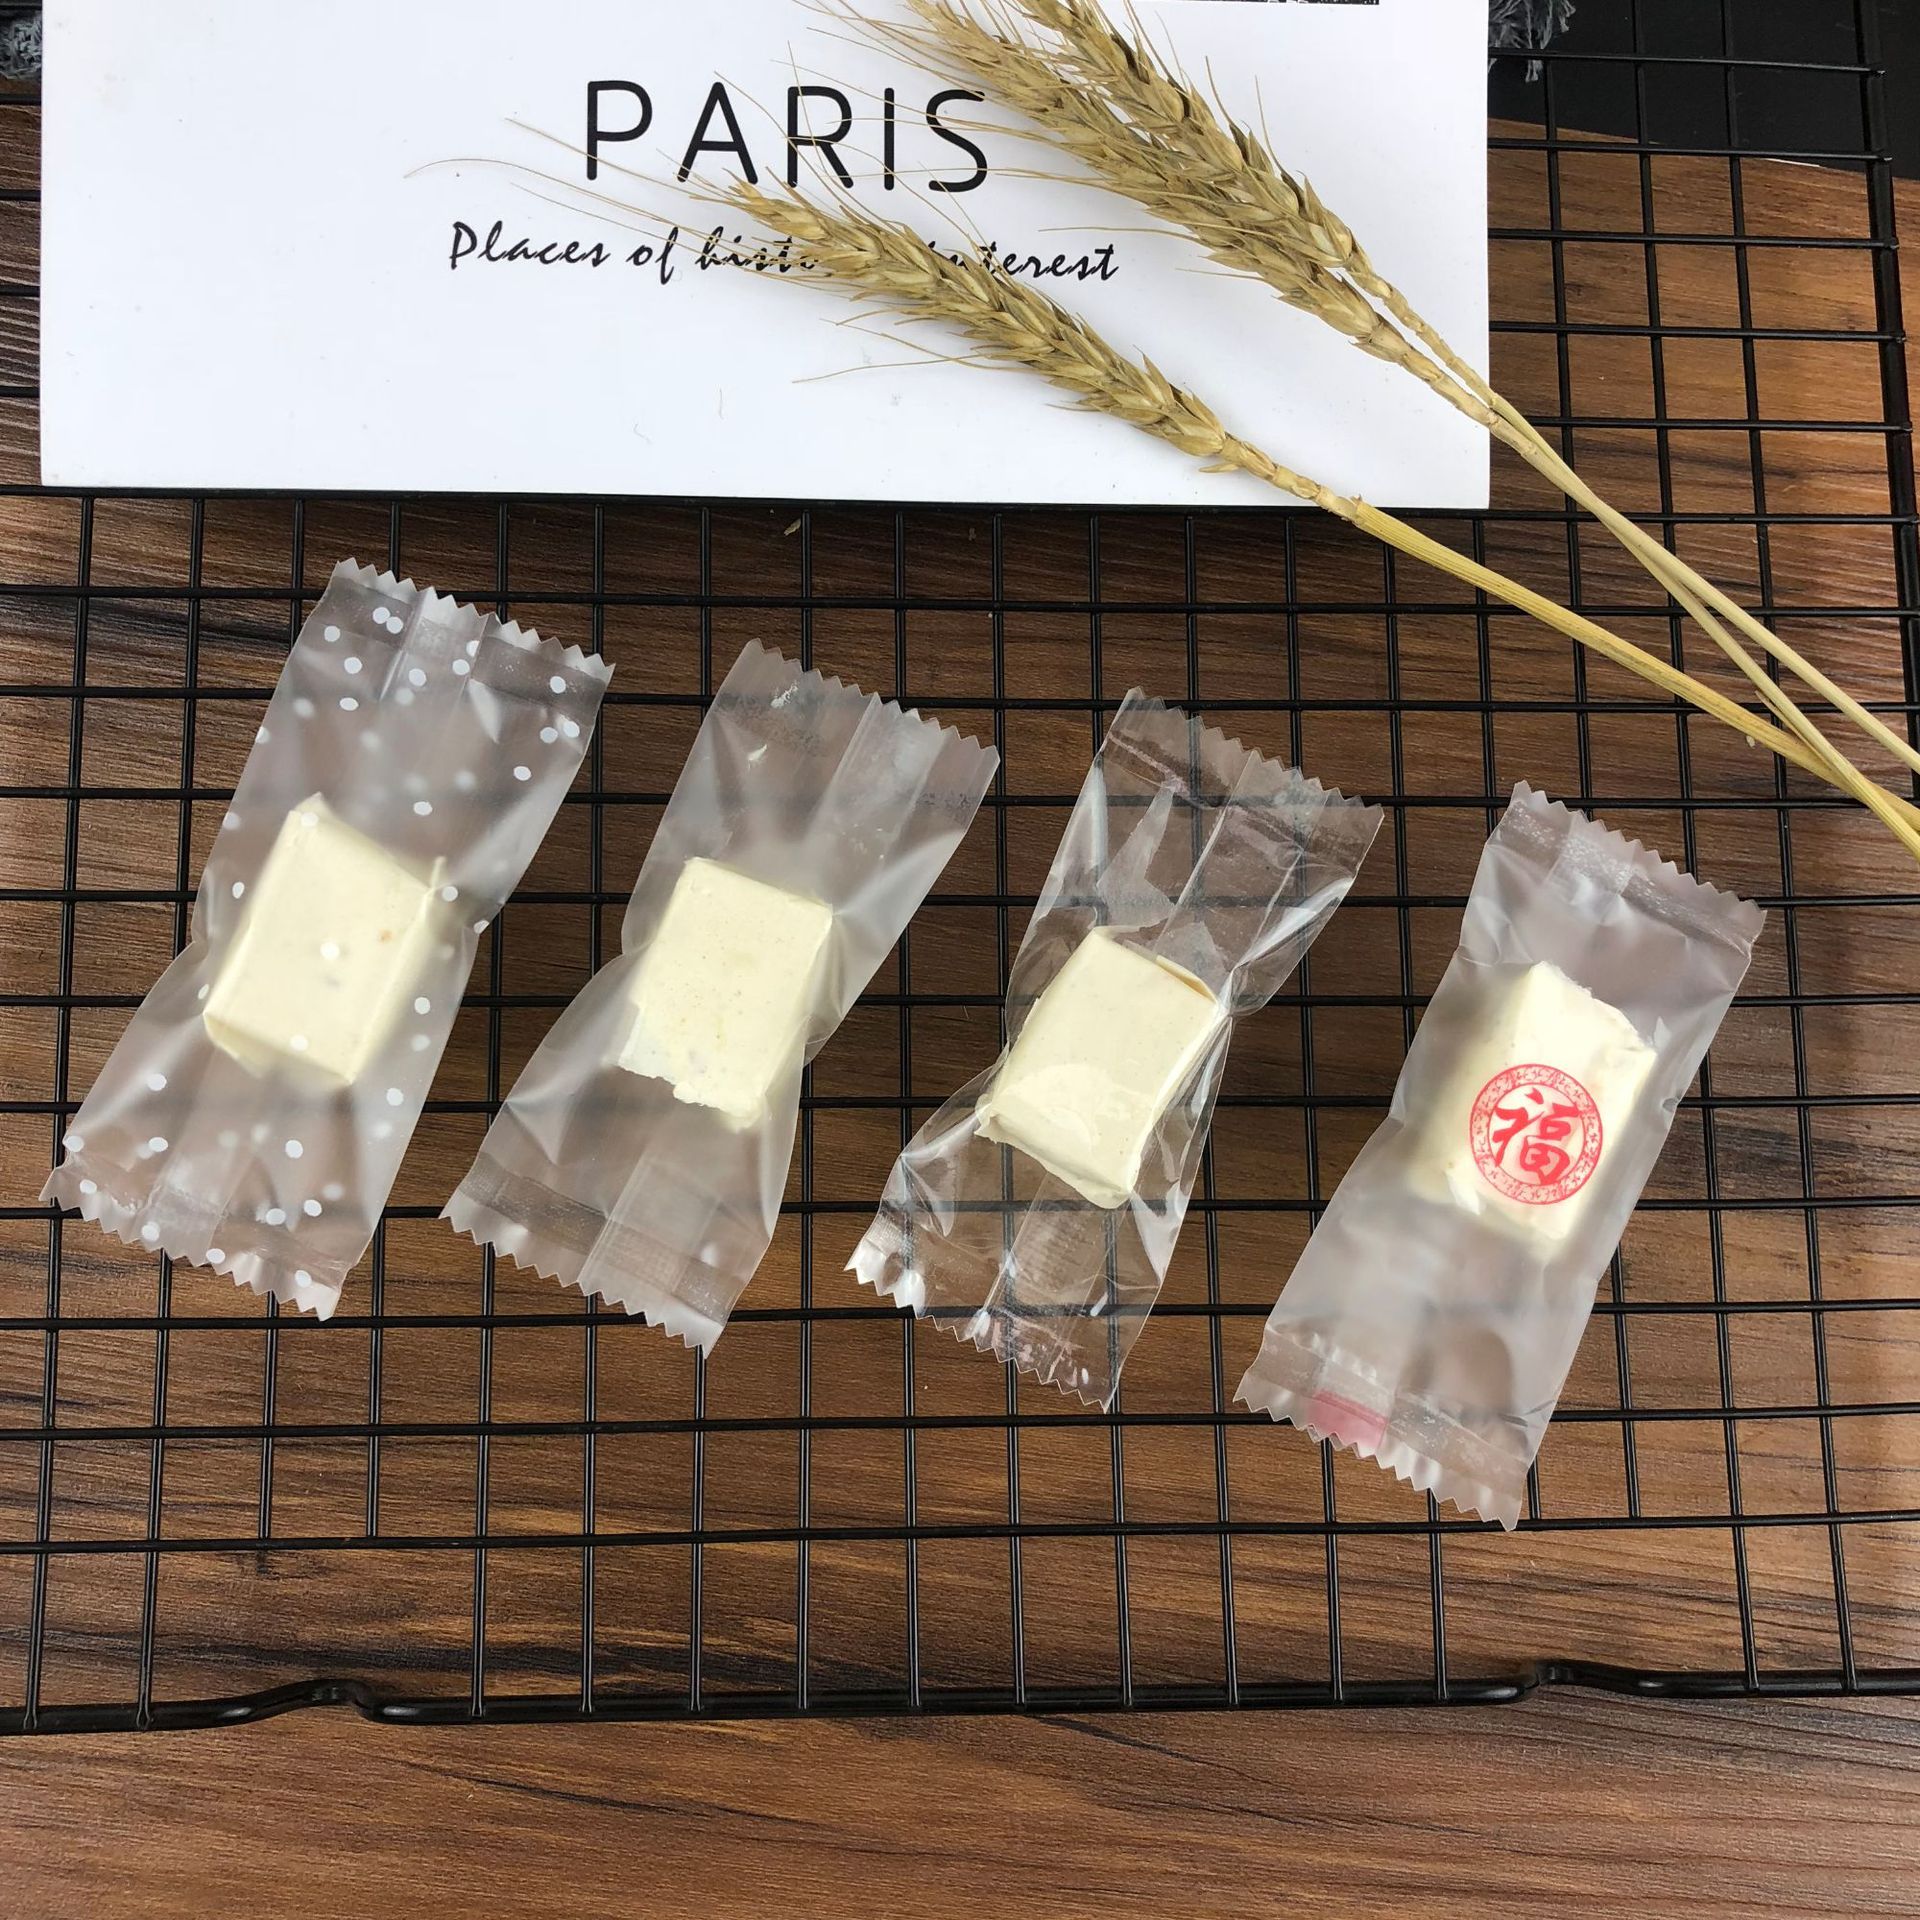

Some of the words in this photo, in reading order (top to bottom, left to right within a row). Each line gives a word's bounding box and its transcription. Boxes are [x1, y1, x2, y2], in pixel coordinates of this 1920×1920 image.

[586, 80, 987, 193] PARIS
[449, 220, 611, 270] Places
[626, 226, 679, 285] of
[1492, 1087, 1579, 1186] 福
